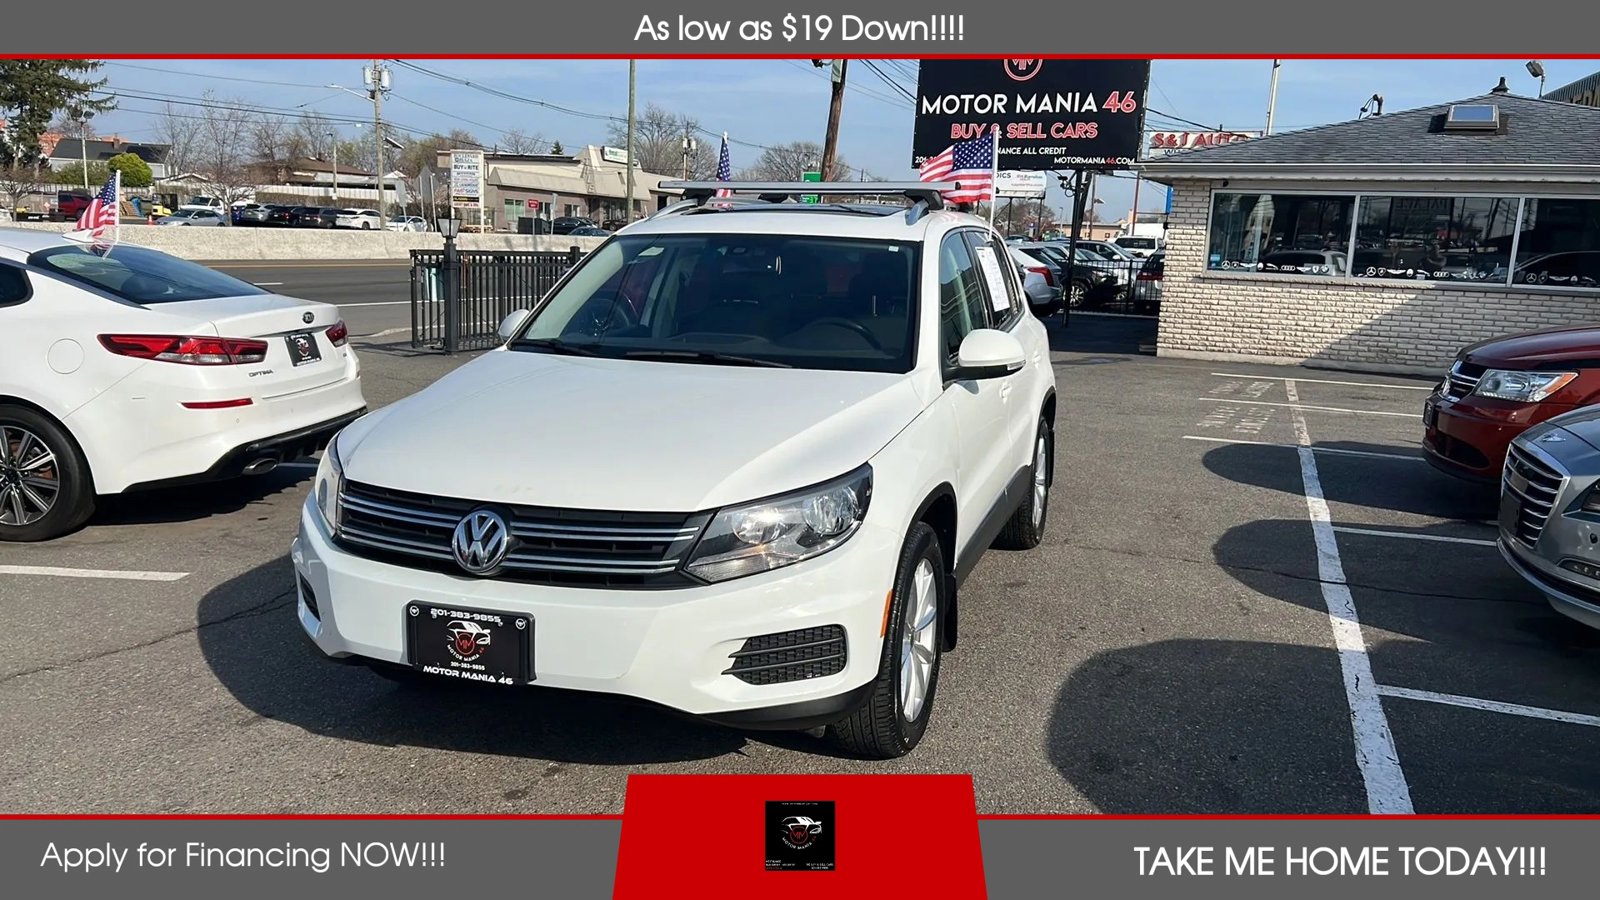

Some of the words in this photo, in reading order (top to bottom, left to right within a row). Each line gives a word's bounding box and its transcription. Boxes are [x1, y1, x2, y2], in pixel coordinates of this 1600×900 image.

[922, 94, 1007, 114] MOTOR
[1016, 92, 1097, 114] MANIA
[1102, 91, 1136, 113] 46
[951, 123, 987, 139] BUY
[1007, 123, 1046, 139] SELL
[1051, 122, 1098, 138] CARS
[1022, 147, 1037, 155] ALL
[1038, 147, 1066, 155] CREDIT
[1054, 156, 1135, 165] MOTORMANIA46.COM
[430, 608, 502, 623] 201-383-9855
[423, 665, 460, 678] MOTOR
[461, 671, 496, 683] MANIA
[498, 677, 513, 685] 46
